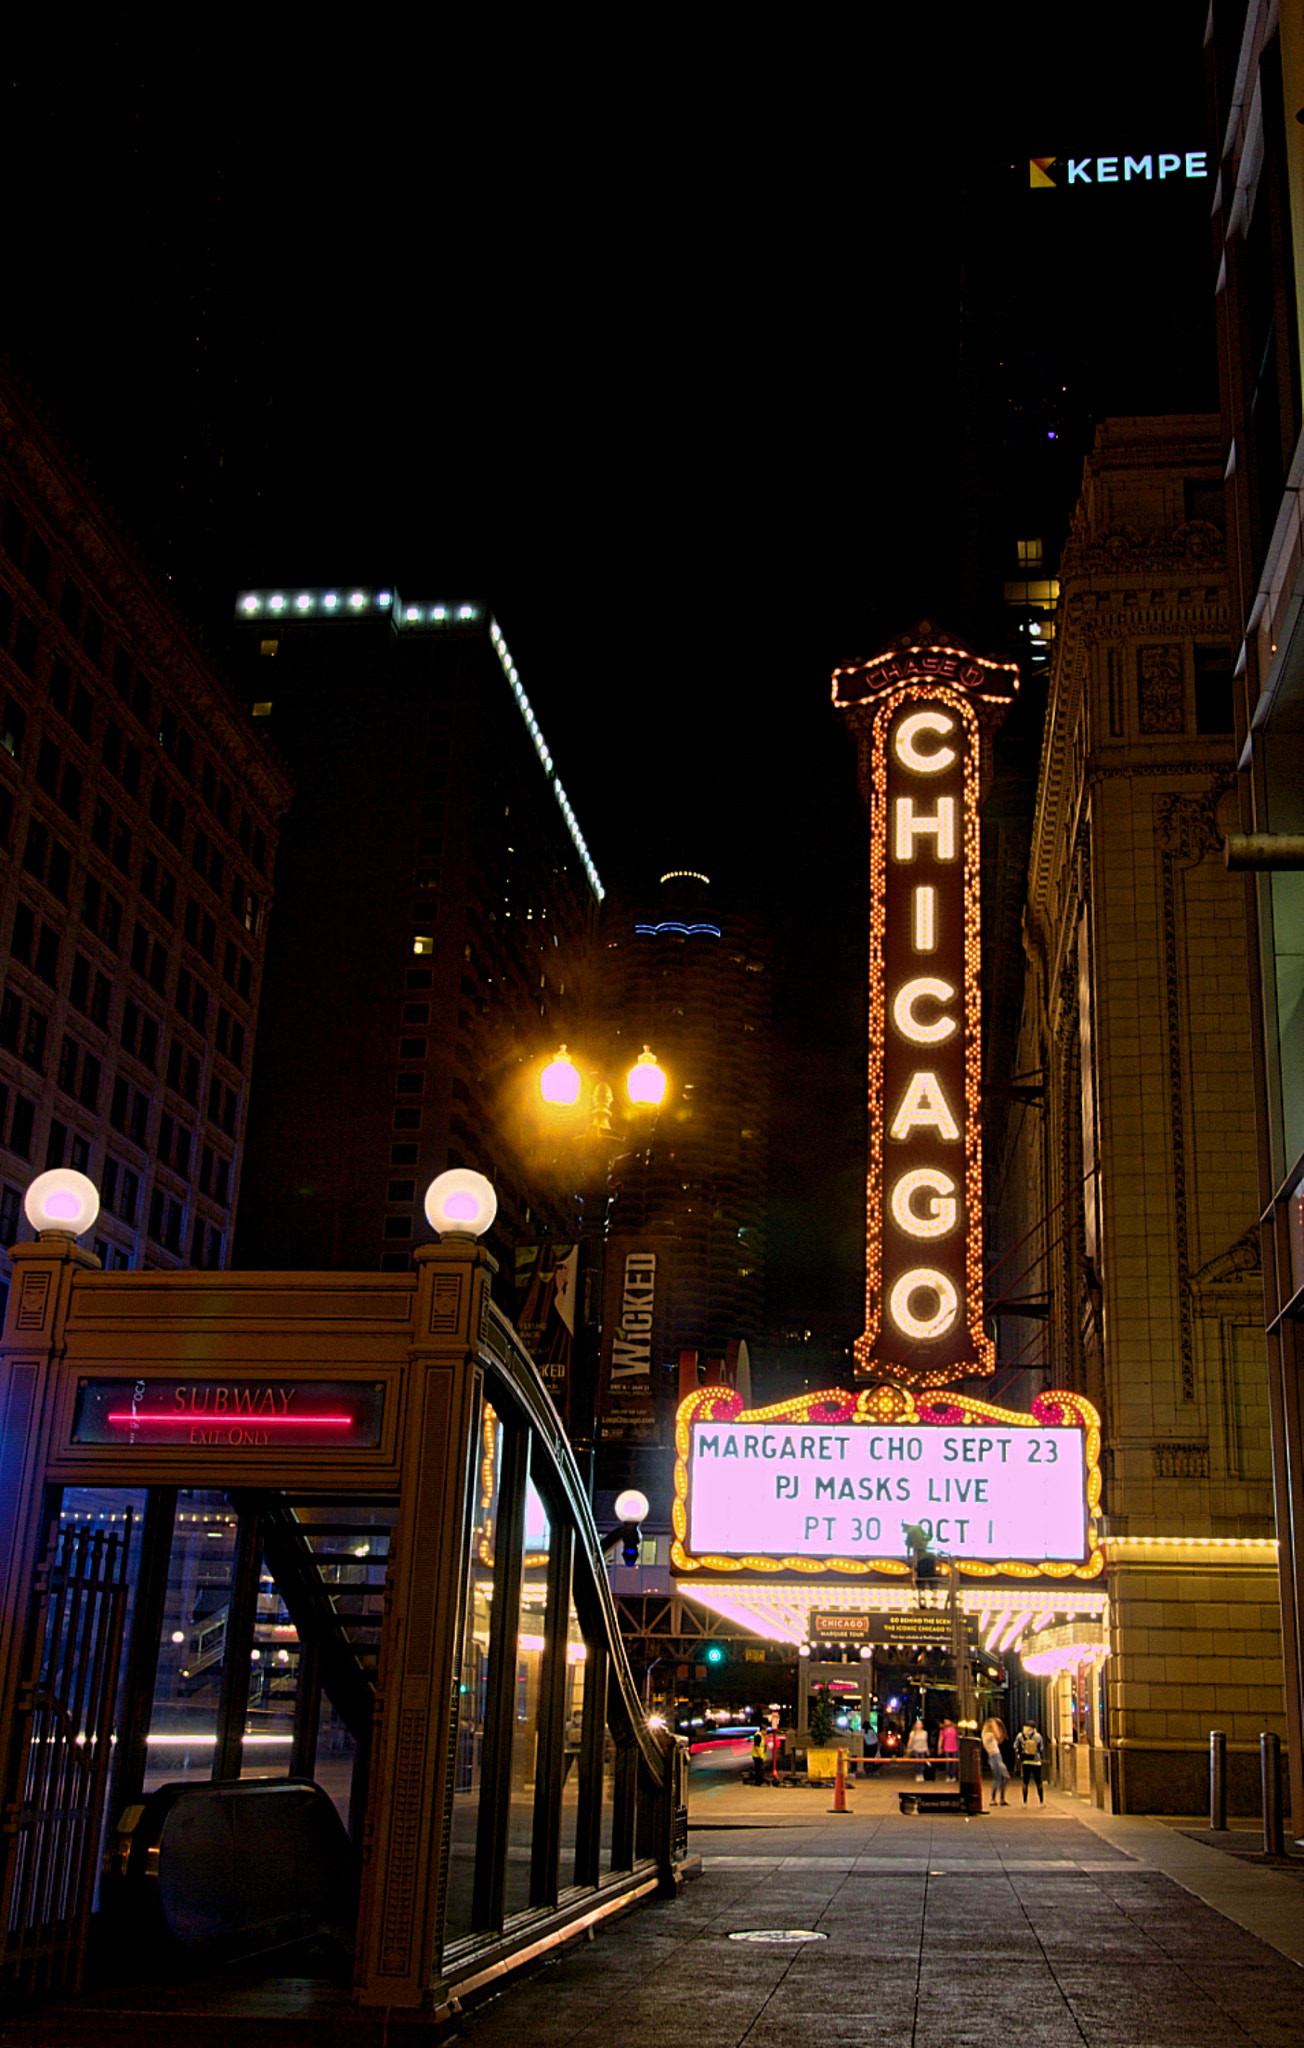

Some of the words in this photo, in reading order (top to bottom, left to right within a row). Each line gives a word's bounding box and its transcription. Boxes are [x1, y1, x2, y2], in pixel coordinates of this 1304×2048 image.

[866, 657, 959, 689] CHASE
[890, 711, 960, 1338] CHICAGO
[173, 1386, 296, 1414] SUBWAY
[698, 1434, 851, 1461] MARGARET
[868, 1436, 924, 1462] CHO
[943, 1438, 1012, 1463] SEPT
[1027, 1439, 1059, 1464] 23
[775, 1475, 800, 1500] PJ
[815, 1476, 911, 1502] MASKS
[928, 1478, 989, 1503] LIVE
[804, 1516, 837, 1541] PT
[851, 1517, 882, 1541] 30
[918, 1518, 970, 1544] OCT
[821, 1619, 863, 1628] CHICAGO
[918, 1625, 945, 1633] CHICAGO
